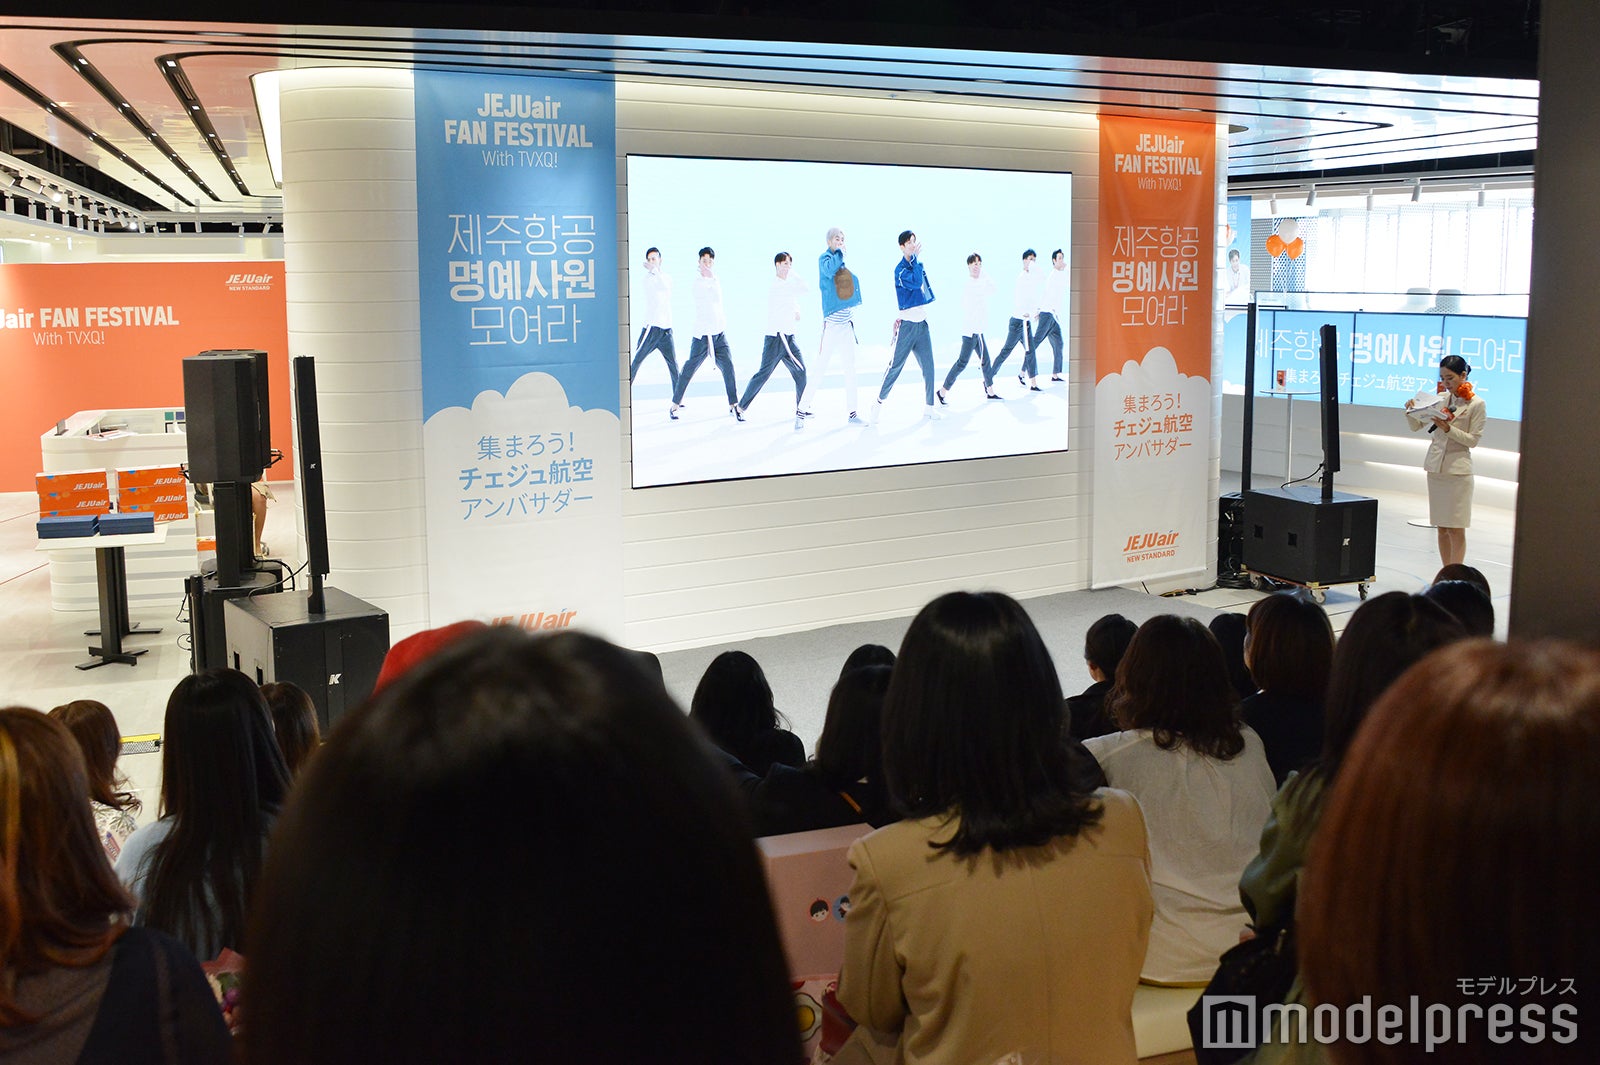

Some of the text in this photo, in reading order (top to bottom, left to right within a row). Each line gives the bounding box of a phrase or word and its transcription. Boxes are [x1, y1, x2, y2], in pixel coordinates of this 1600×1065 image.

[477, 92, 561, 119] JEJUair
[444, 119, 593, 148] FAN FESTIVAL
[1135, 133, 1184, 154] JEJUair
[482, 150, 558, 169] With TVXQ!
[1114, 153, 1202, 176] FAN FESTIVAL
[1137, 176, 1182, 191] With TVXQ!
[447, 213, 596, 256] 제주항공
[1111, 225, 1200, 258] 제주항공
[225, 273, 273, 284] JEJUair
[449, 258, 596, 302] 명예사원
[1111, 260, 1199, 293] 명예사원
[40, 307, 79, 328] FAN
[85, 305, 180, 327] FESTIVAL
[1121, 294, 1188, 327] 모여라
[469, 303, 582, 346] 모여라
[33, 330, 105, 346] With TVXQ!
[1349, 332, 1453, 368] 명예사원
[1123, 393, 1181, 414] 集まろう!
[1113, 413, 1193, 438] チェジュ航空
[477, 431, 574, 461] 集まろう!
[1114, 437, 1192, 461] アンバサダー
[458, 457, 594, 491] チェジュ航空
[461, 488, 593, 521] アンバサダー
[1123, 530, 1179, 552] JEJUair
[1126, 549, 1176, 563] NEW STANDARD
